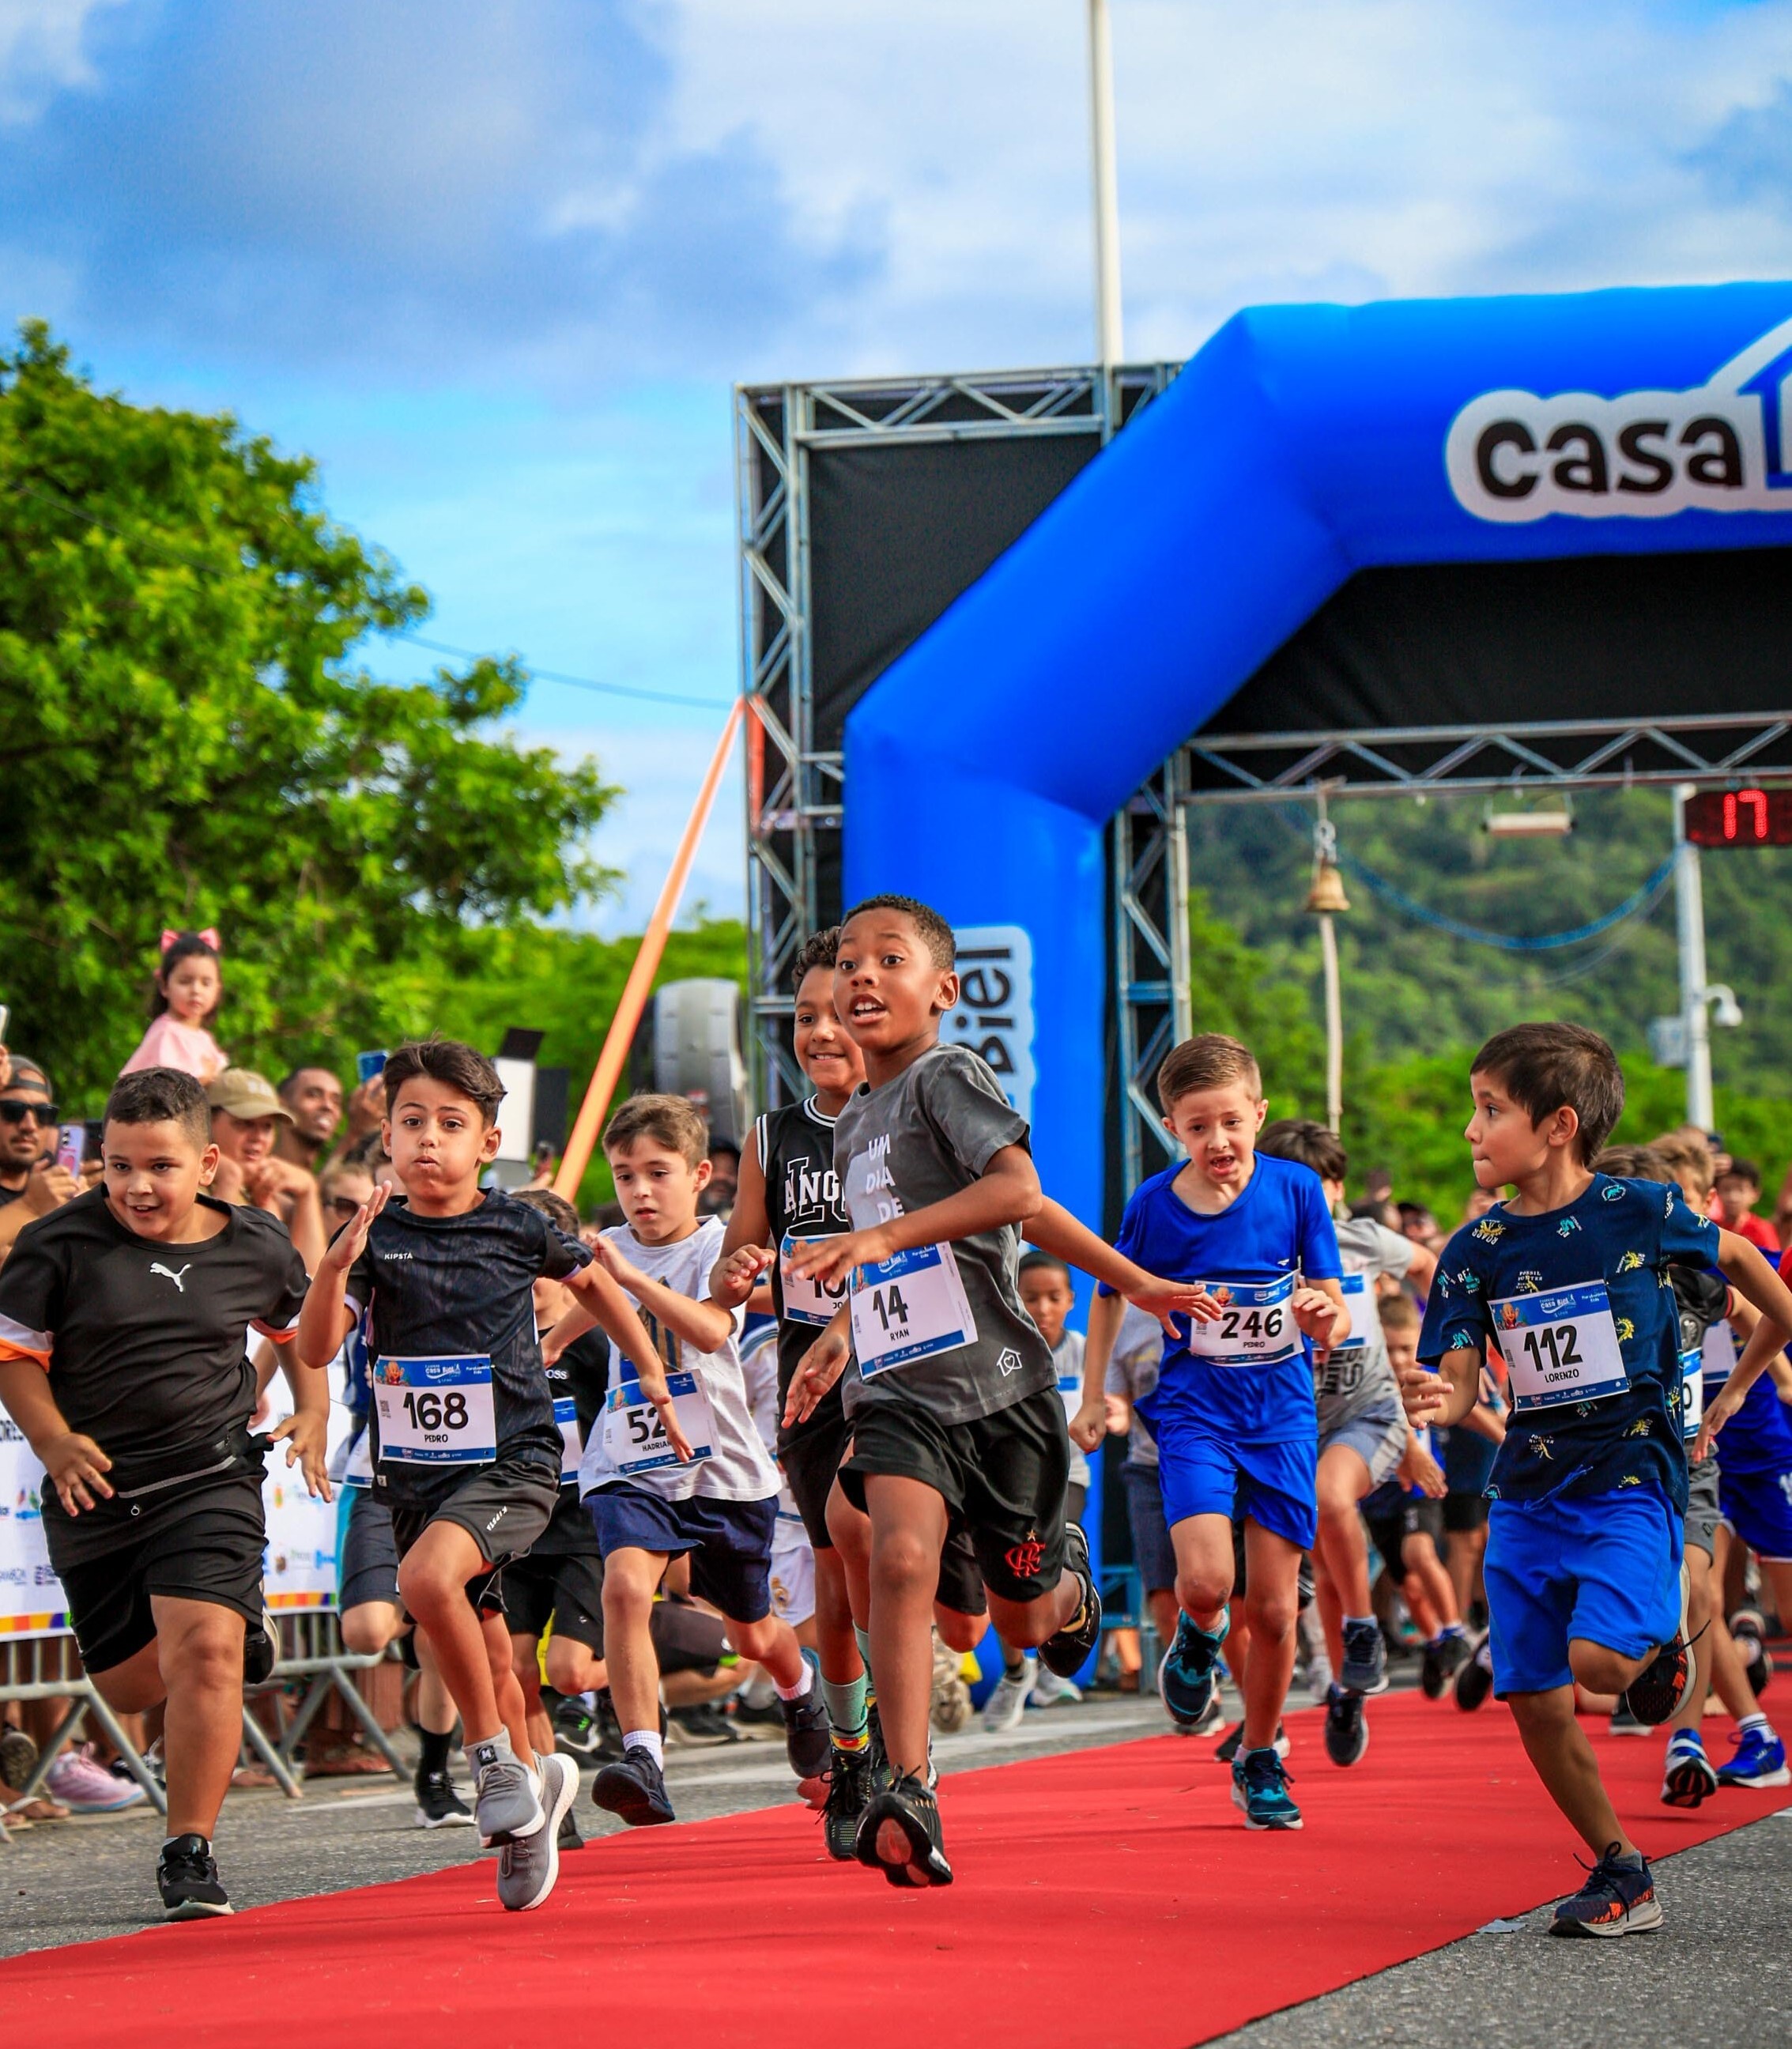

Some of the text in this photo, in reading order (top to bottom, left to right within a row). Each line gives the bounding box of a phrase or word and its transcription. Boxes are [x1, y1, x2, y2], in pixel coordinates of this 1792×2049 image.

[1722, 788, 1768, 840] 17
[868, 1134, 891, 1160] UM
[784, 1170, 845, 1215] ANG
[866, 1166, 896, 1195] DIA
[876, 1197, 905, 1224] DE
[872, 1285, 909, 1331] 14
[889, 1329, 910, 1341] RYAN
[1220, 1308, 1282, 1339] 246
[1523, 1324, 1583, 1372] 112
[545, 1369, 568, 1380] OSS
[1544, 1368, 1579, 1383] LORENZO
[402, 1392, 469, 1431] 168
[626, 1406, 667, 1444] 52
[424, 1434, 449, 1443] PEDRO
[486, 1505, 507, 1531] KIPSTA
